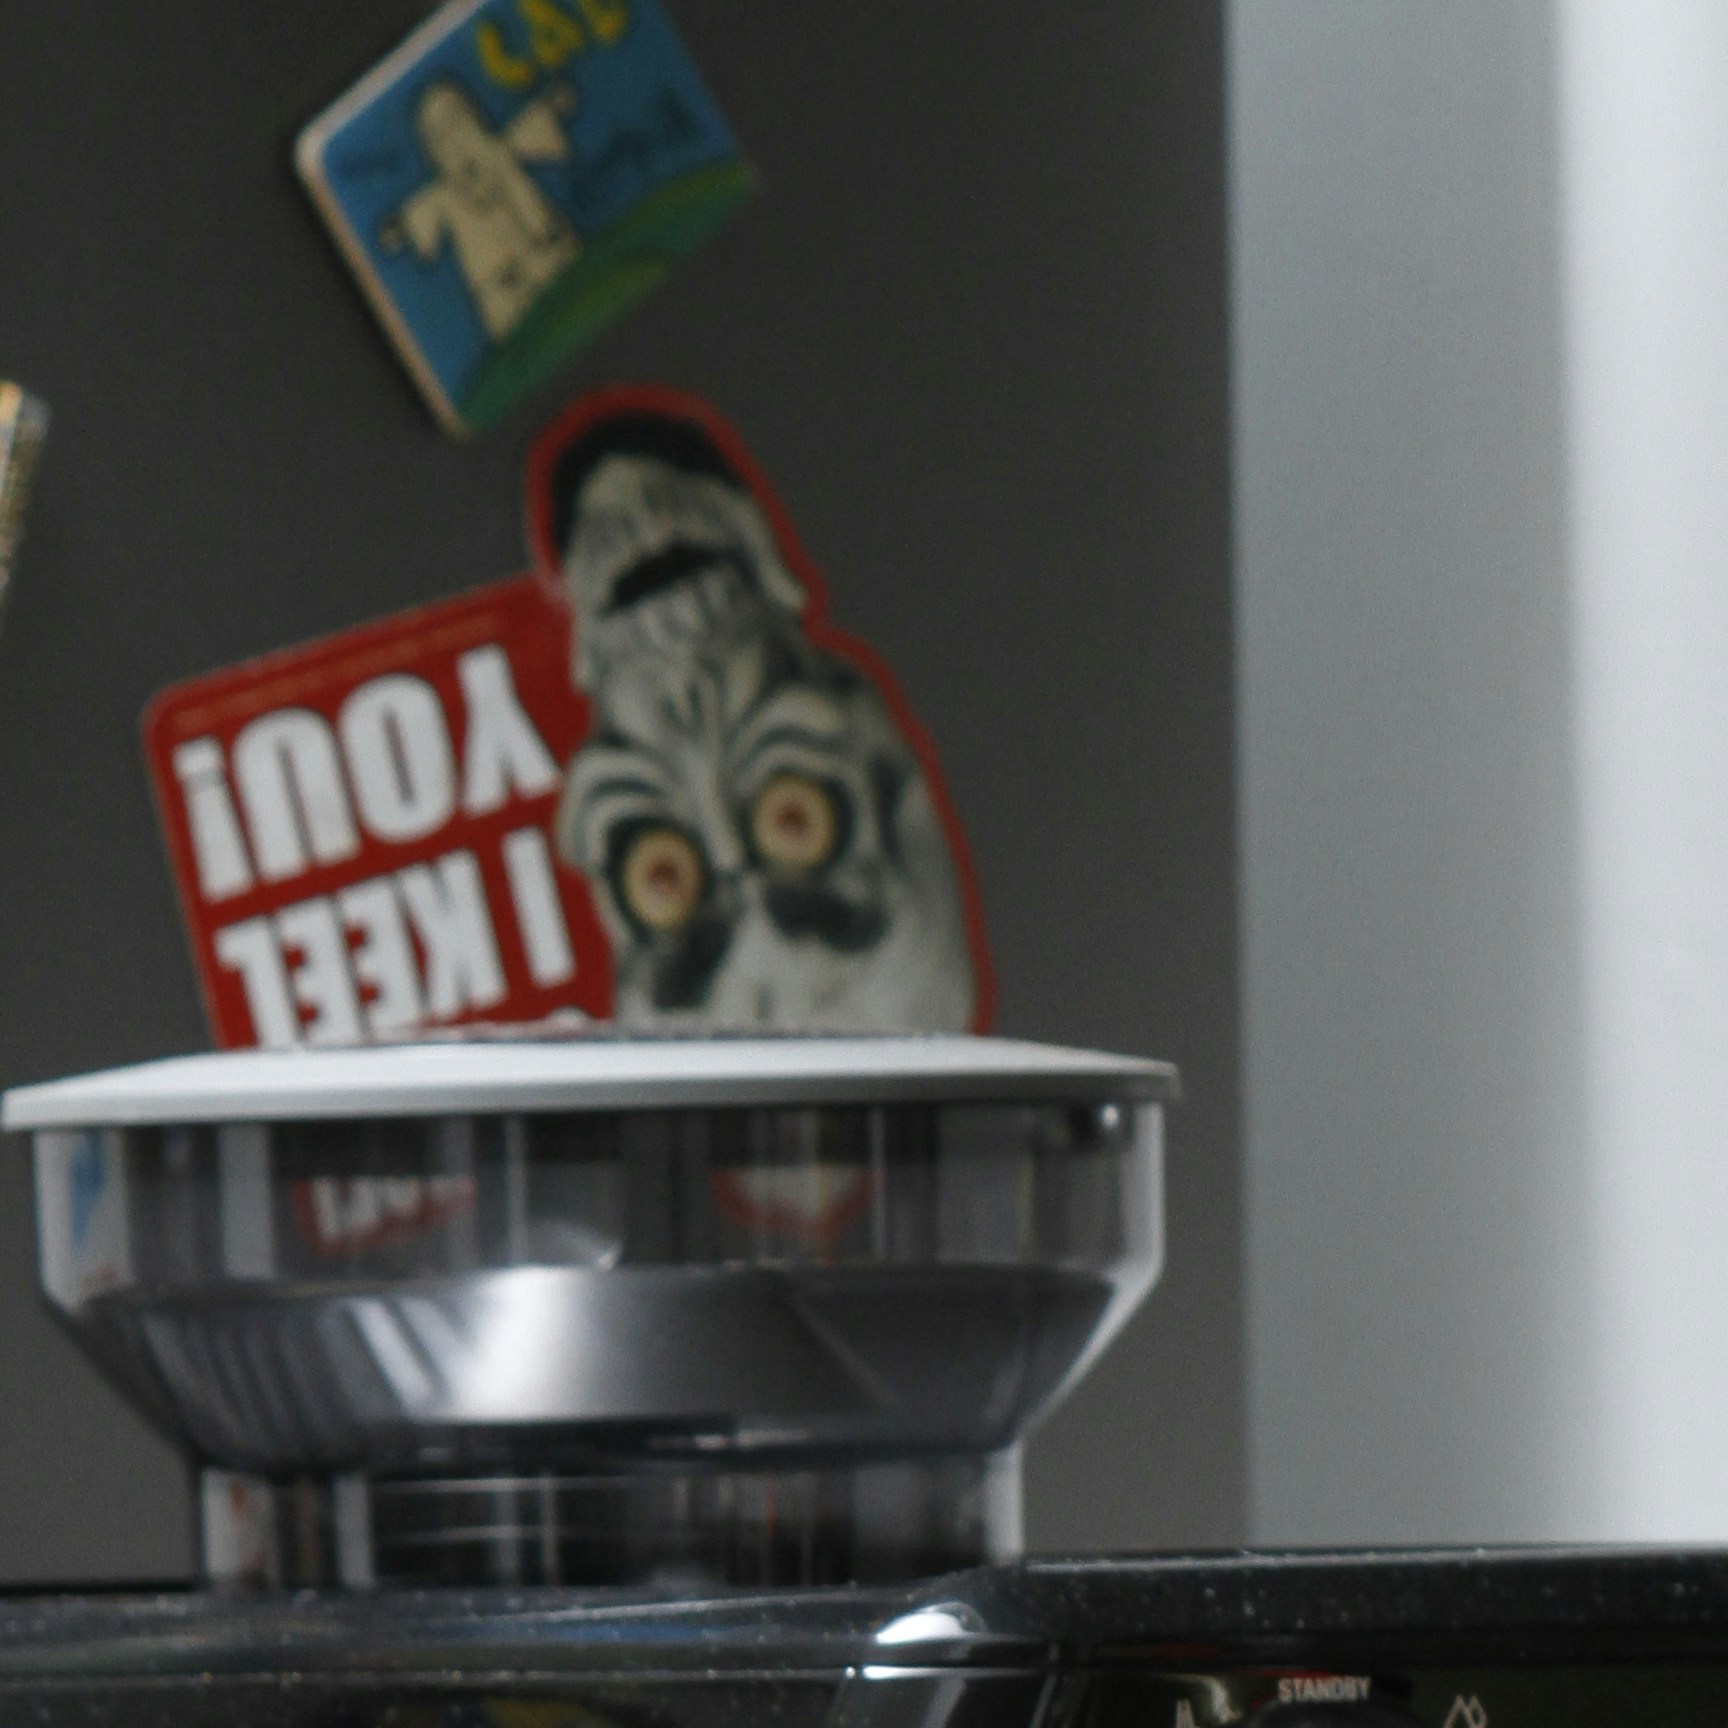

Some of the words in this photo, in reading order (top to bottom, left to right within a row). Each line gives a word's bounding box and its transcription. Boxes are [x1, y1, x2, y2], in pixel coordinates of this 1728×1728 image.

[172, 642, 561, 902] YOU!
[213, 847, 509, 1048] KEEL
[502, 824, 575, 988] I
[1278, 1675, 1371, 1704] STANDBY
